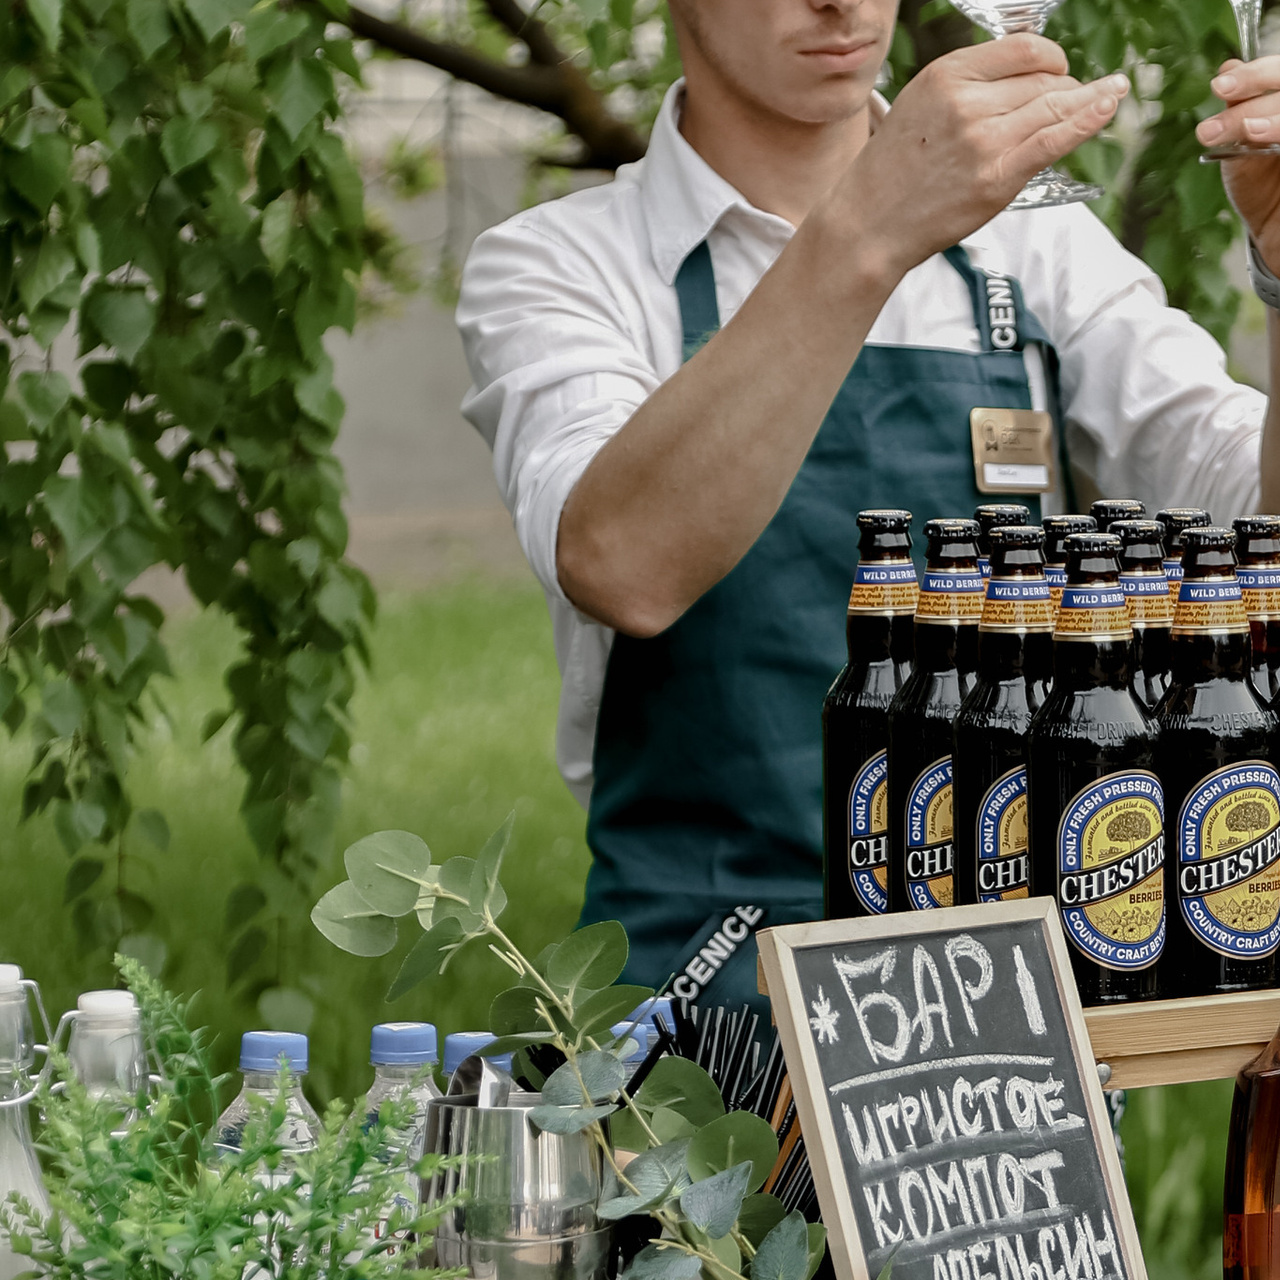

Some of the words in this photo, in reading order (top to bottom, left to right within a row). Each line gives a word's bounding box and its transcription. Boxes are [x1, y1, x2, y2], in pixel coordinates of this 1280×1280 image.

[863, 571, 887, 581] WILD
[929, 579, 953, 588] WILD
[1165, 568, 1184, 577] WIL
[995, 587, 1019, 596] WILD
[1072, 595, 1099, 604] WILD
[1190, 589, 1216, 598] WILD
[915, 771, 946, 806] FRESH
[1102, 780, 1152, 800] PRESSED
[1221, 771, 1271, 790] PRESSED
[855, 795, 866, 830] ONLY
[987, 781, 1020, 817] FRESH
[1069, 792, 1103, 829] FRESH
[1100, 807, 1114, 821] and
[1115, 800, 1138, 813] bottled
[1189, 783, 1222, 820] FRESH
[1219, 798, 1233, 812] and
[1234, 791, 1258, 804] bottled
[911, 806, 922, 841] ONLY
[984, 817, 995, 853] ONLY
[1185, 820, 1197, 856] ONLY
[1066, 829, 1078, 865] ONLY
[1129, 889, 1162, 904] BERRIES
[1248, 880, 1280, 894] BERRIES
[1069, 911, 1115, 959] COUNTRY
[1116, 944, 1151, 960] CRAFT
[1189, 901, 1236, 948] COUNTRY
[1235, 933, 1270, 950] CRAFT
[832, 933, 994, 1065] БАР
[841, 1072, 1086, 1167] ИГРИСТОЕ
[862, 1149, 1066, 1248] КОМПОТ
